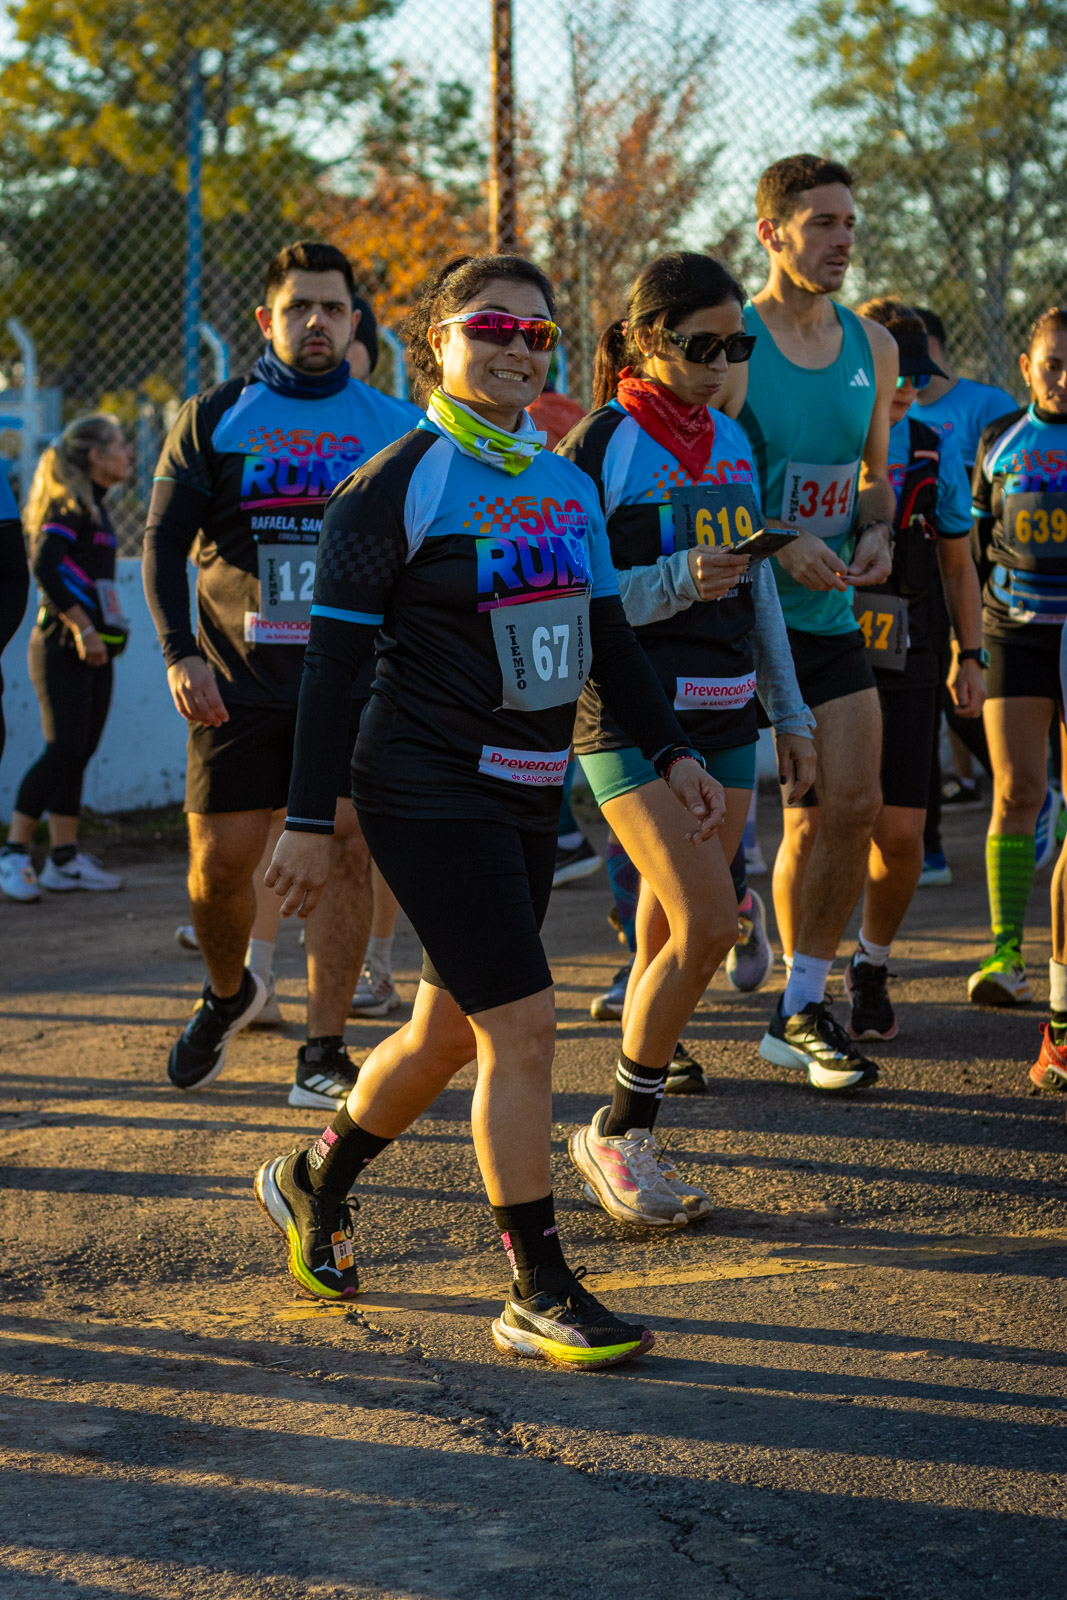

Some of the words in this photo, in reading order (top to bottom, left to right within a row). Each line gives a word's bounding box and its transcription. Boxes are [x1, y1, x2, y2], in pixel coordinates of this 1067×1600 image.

[799, 477, 851, 518] 344
[251, 516, 298, 532] RAFAELA,
[556, 513, 588, 526] MILLAS
[695, 505, 754, 549] 619
[1015, 509, 1067, 543] 639
[475, 536, 593, 594] RUN
[505, 624, 527, 690] TIEMPO
[532, 624, 570, 682] 67
[576, 615, 584, 681] EXACTO
[489, 752, 568, 772] Prevención
[522, 775, 552, 784] SANCOR
